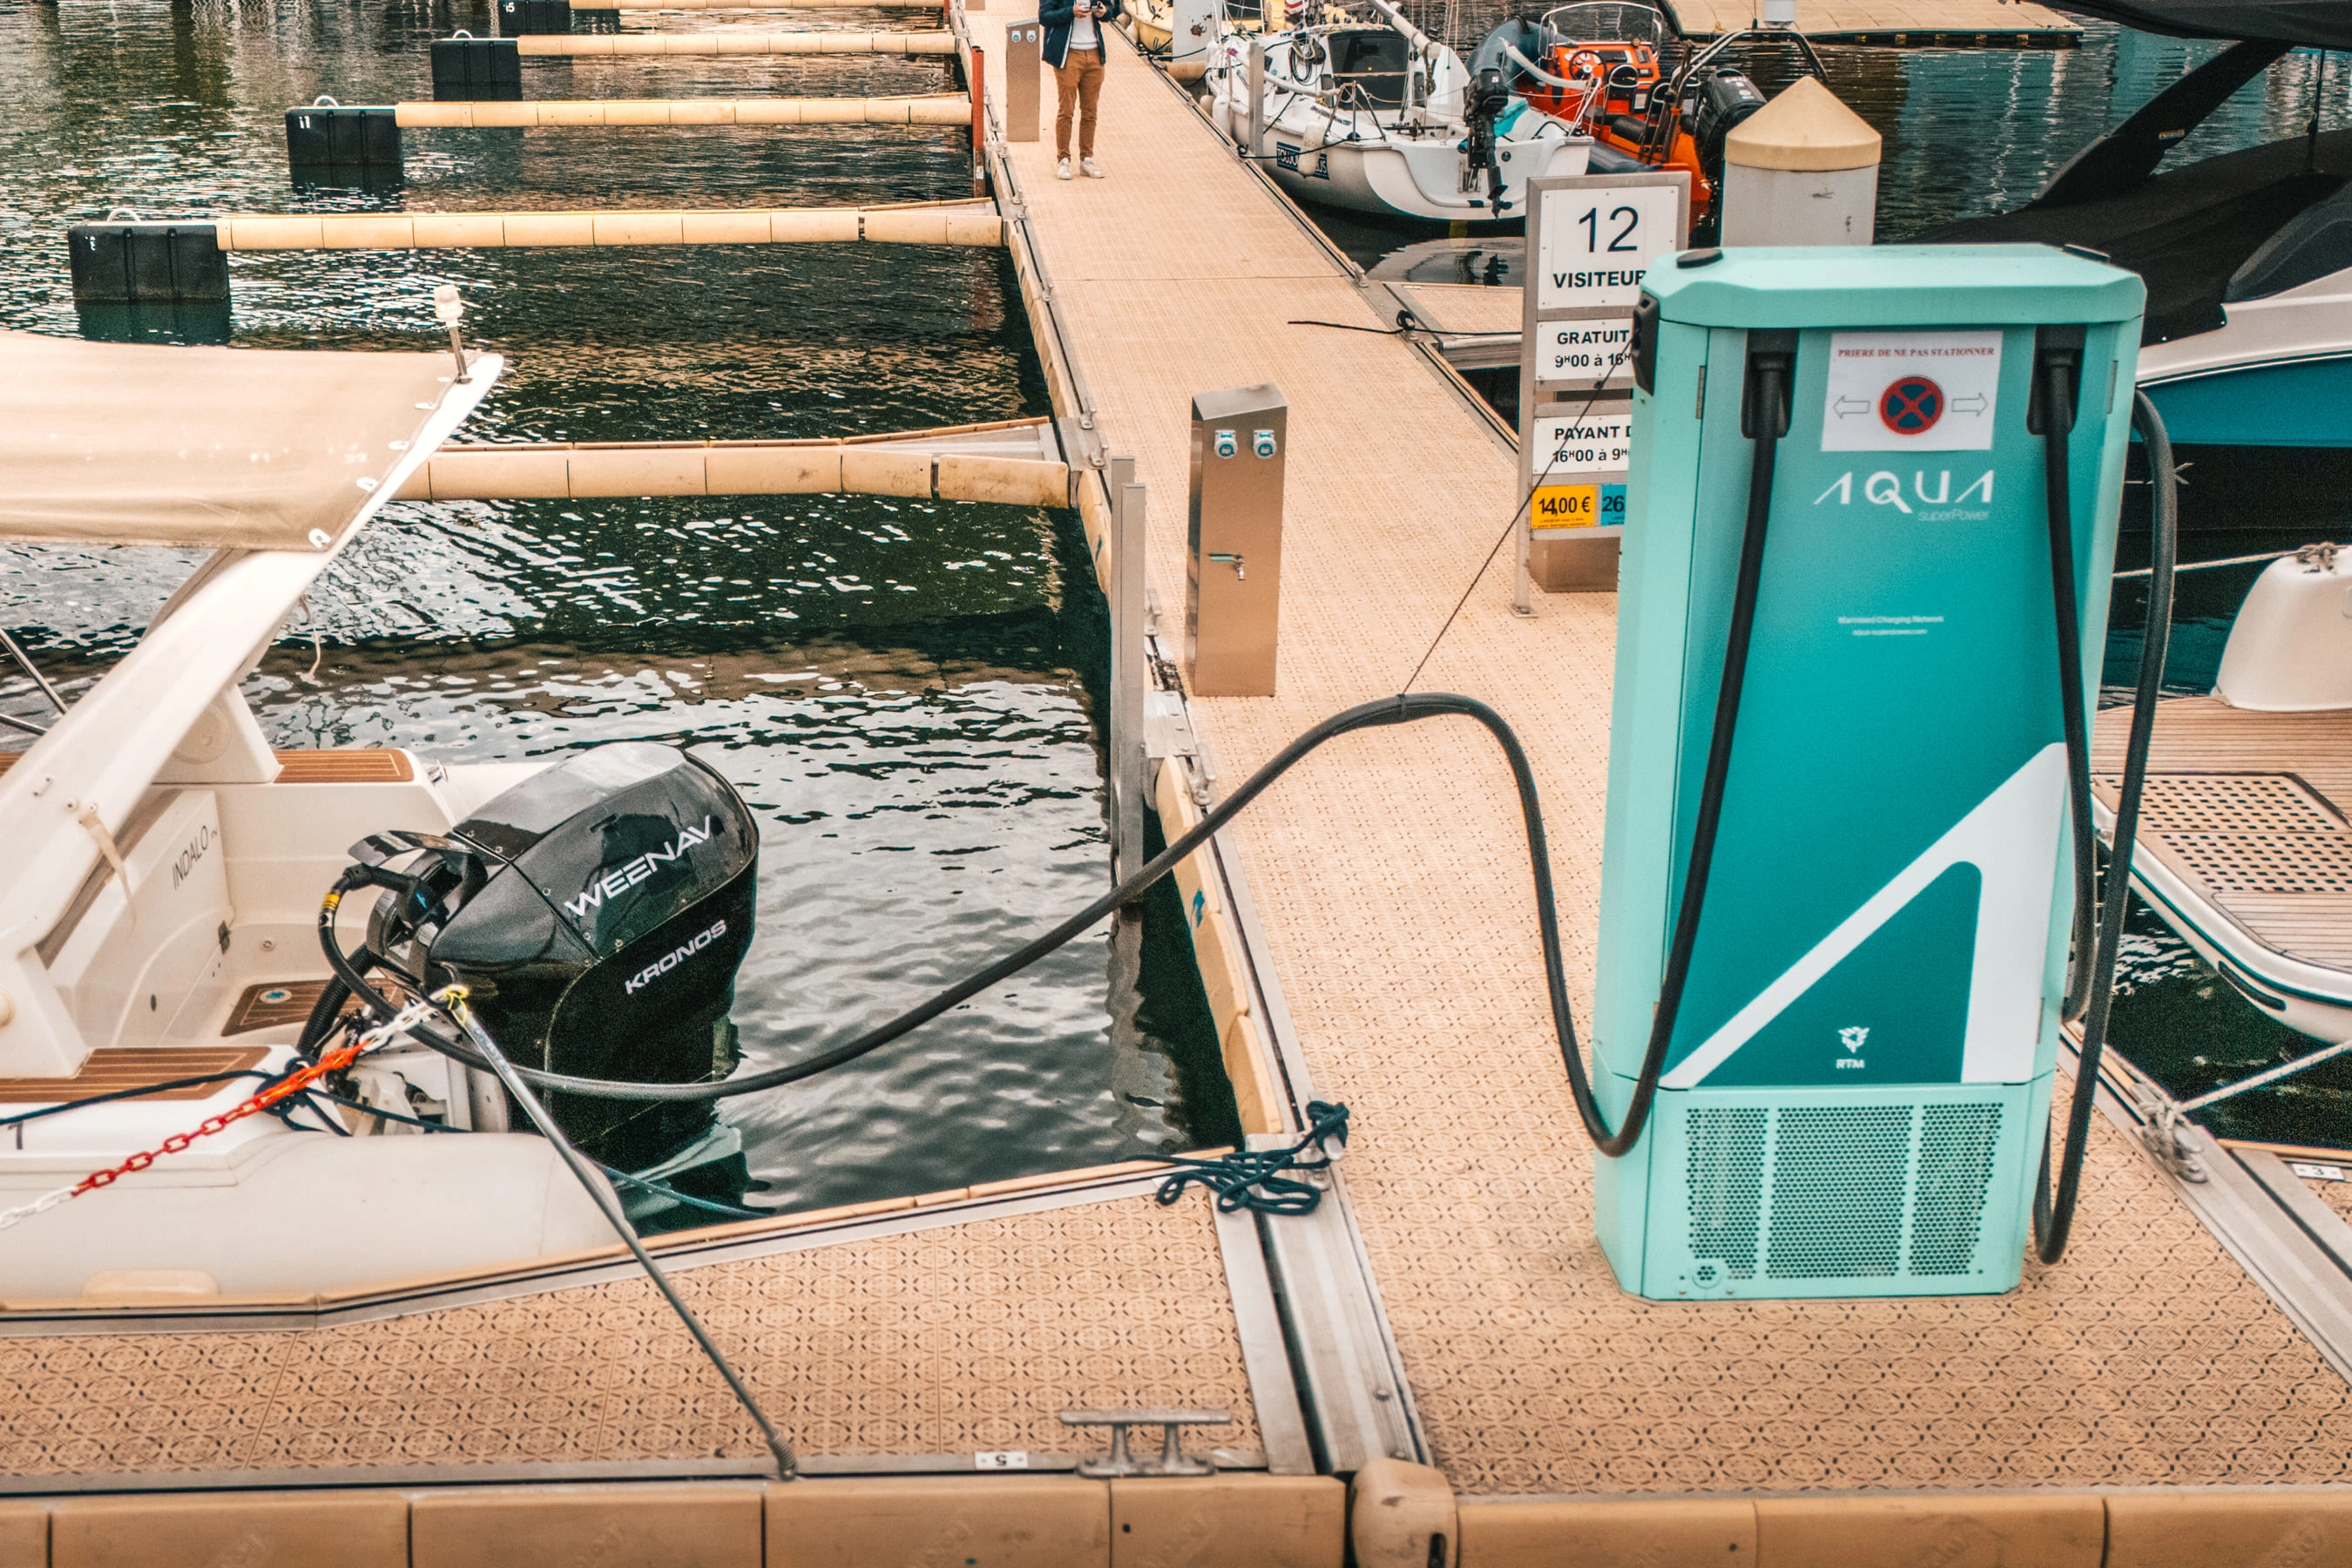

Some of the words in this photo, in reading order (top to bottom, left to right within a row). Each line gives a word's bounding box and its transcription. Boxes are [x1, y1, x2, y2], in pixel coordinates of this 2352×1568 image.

[1578, 206, 1639, 253] 12
[1558, 330, 1630, 345] GRATUIT
[1594, 354, 1603, 366] à
[1838, 348, 1875, 357] PRIERE
[1878, 348, 1889, 357] DE
[1894, 348, 1908, 357] NE
[1910, 348, 1929, 357] PAS
[1930, 348, 1994, 357] STATIONNER
[1555, 426, 1620, 440] PAYANT
[1598, 449, 1607, 461] à
[1813, 469, 1995, 514] AQUA
[1582, 497, 1591, 513] €
[1602, 495, 1625, 513] 26
[172, 825, 208, 889] INDALO
[564, 814, 711, 916] WEENAV
[625, 919, 727, 995] KRONOS
[1836, 1058, 1865, 1069] RTM
